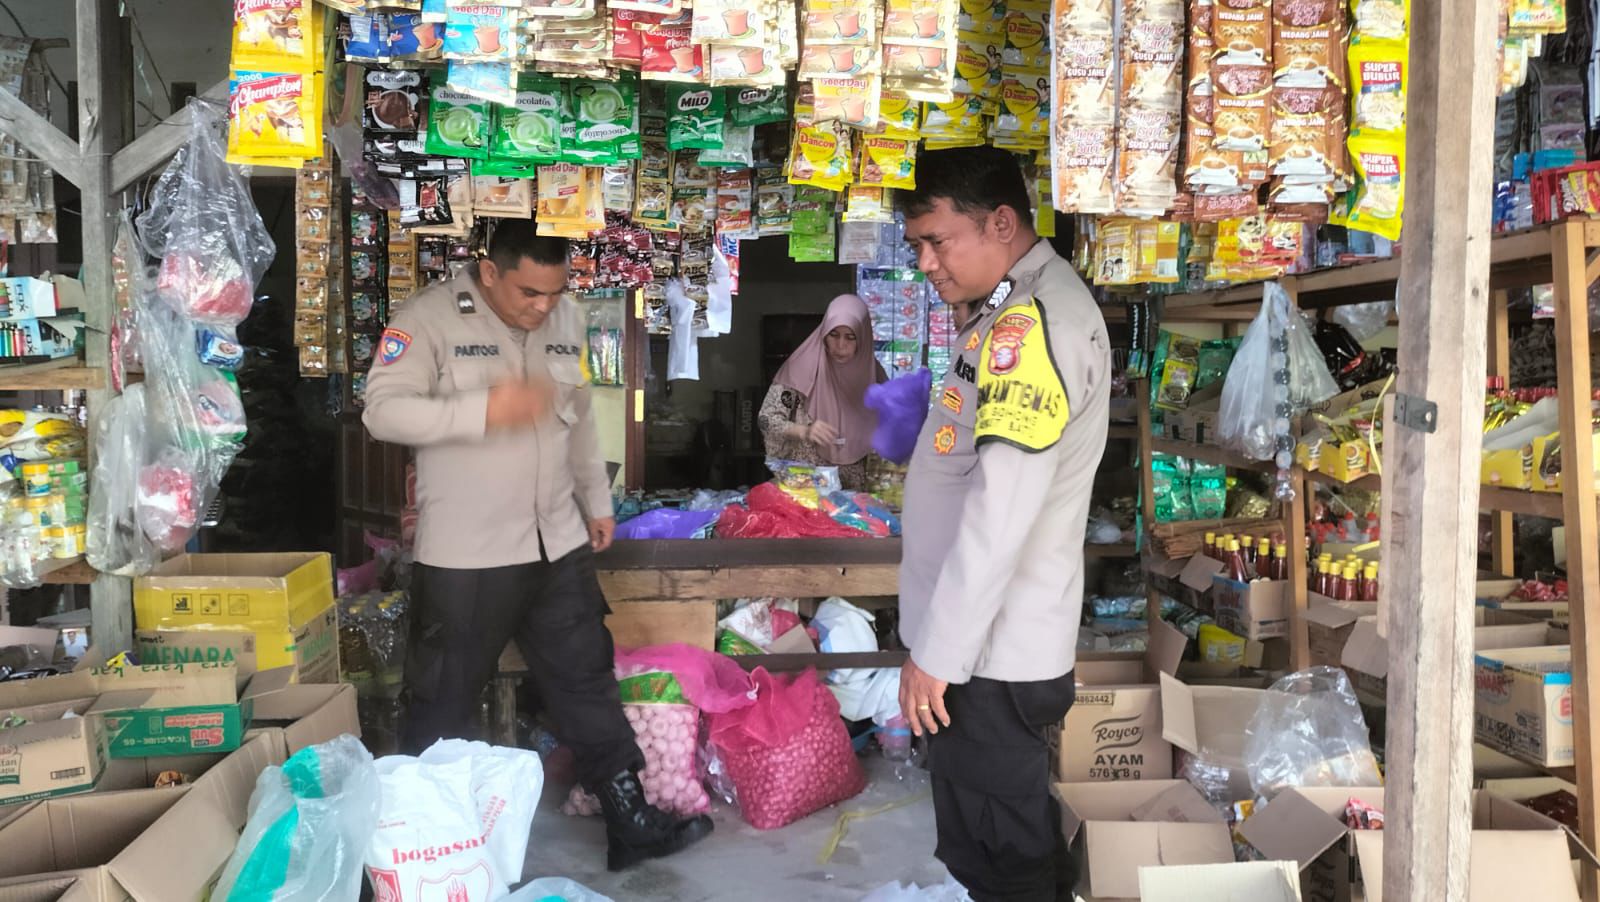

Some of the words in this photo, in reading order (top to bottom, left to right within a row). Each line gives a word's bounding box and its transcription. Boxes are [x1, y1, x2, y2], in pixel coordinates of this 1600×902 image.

[1134, 53, 1153, 62] SUSU
[1154, 52, 1174, 62] JAHE
[1364, 61, 1398, 73] SUPER
[1363, 71, 1401, 82] BUBUR
[239, 78, 302, 104] Champion
[681, 96, 710, 108] MILO
[800, 133, 836, 150] Dancow
[869, 138, 906, 151] Dancow
[683, 266, 706, 276] ABC
[454, 344, 500, 358] PARTOGI
[142, 645, 235, 666] MENARA
[1094, 726, 1140, 743] Royco
[1094, 753, 1144, 766] AYAM
[1089, 767, 1110, 778] 576
[1133, 769, 1141, 780] g
[392, 833, 487, 865] bogasar
